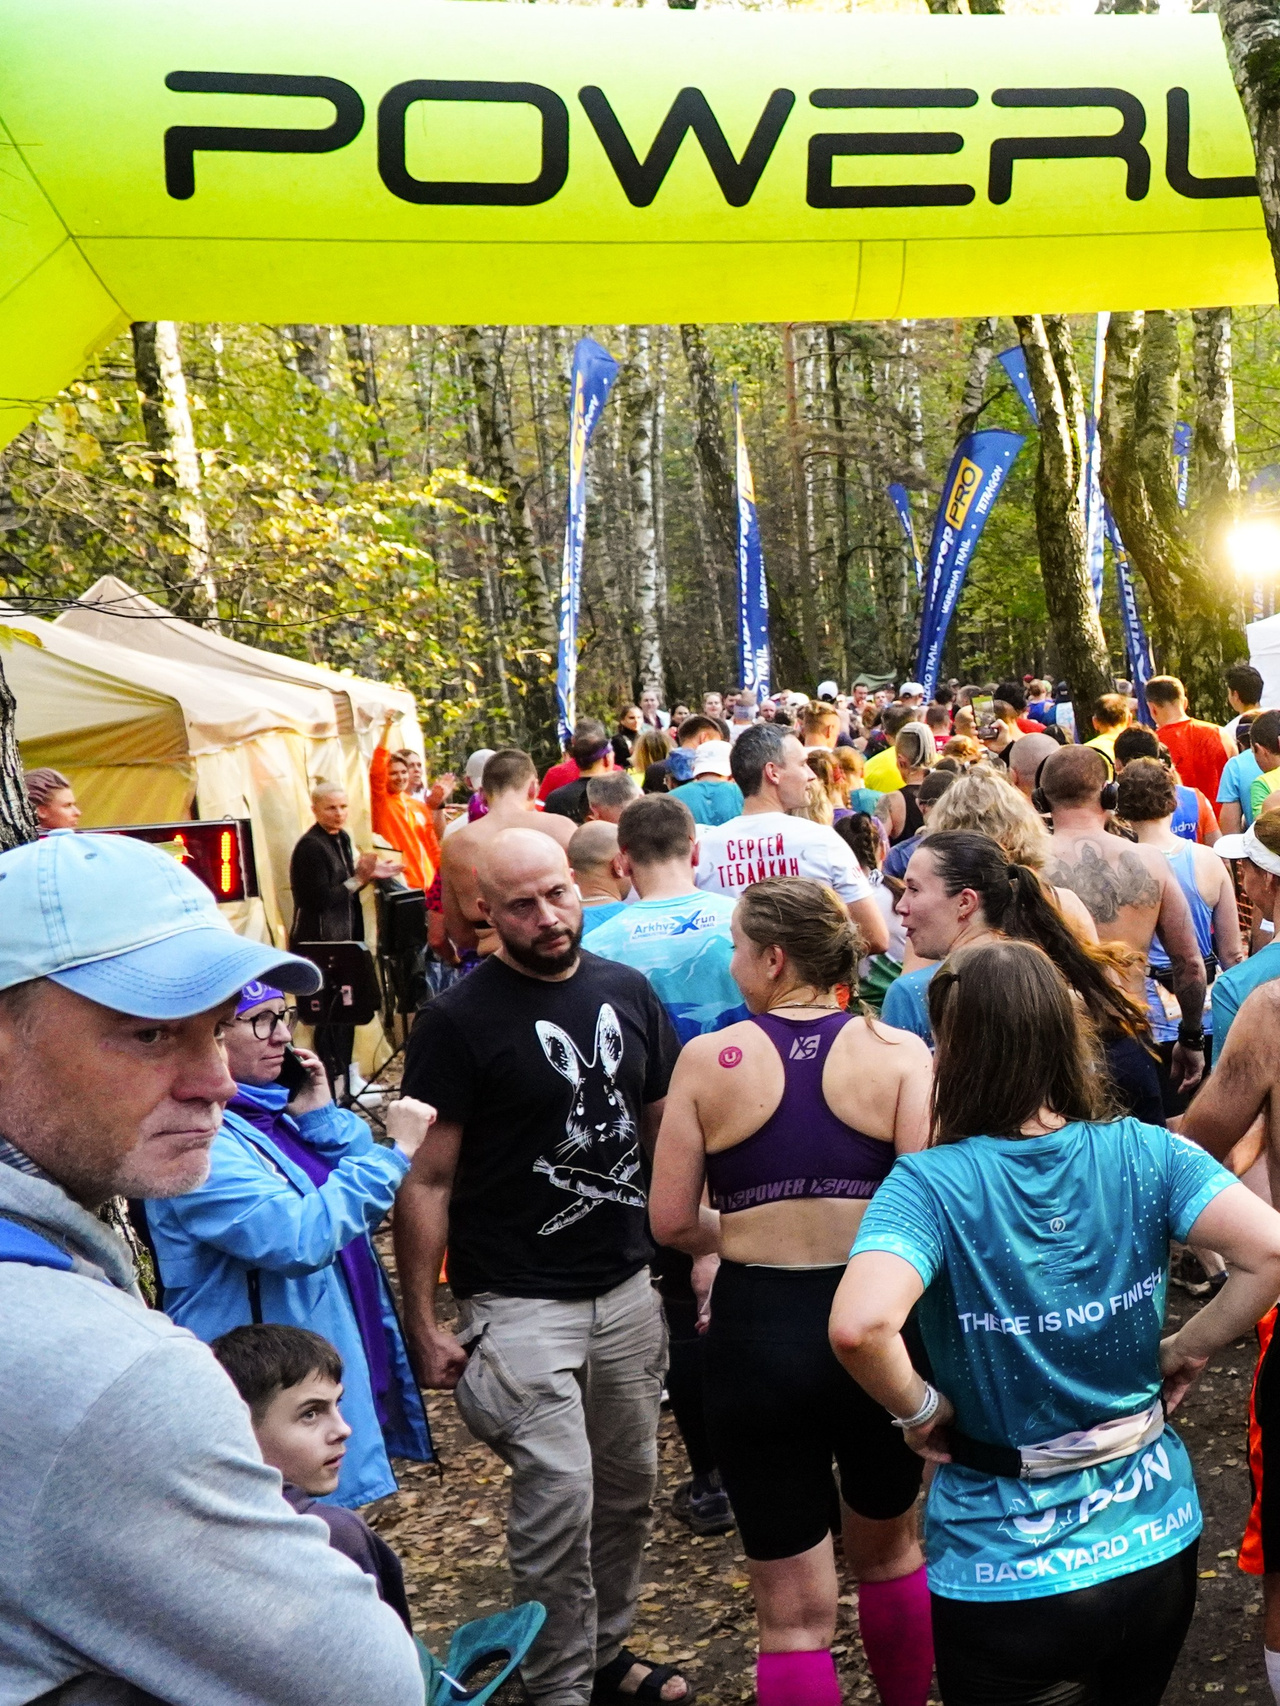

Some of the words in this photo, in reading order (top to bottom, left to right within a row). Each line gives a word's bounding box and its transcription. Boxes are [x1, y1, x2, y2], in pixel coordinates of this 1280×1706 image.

[949, 466, 976, 524] PRO
[954, 538, 971, 567] TRAIL
[975, 464, 1004, 515] TETRAGON
[717, 857, 800, 888] ТЕБАЙКИН
[726, 833, 785, 862] СЕРГЕЙ
[957, 1312, 1031, 1336] THERE
[1038, 1311, 1062, 1333] IS
[1066, 1301, 1105, 1327] NO
[1109, 1266, 1162, 1316] FINISH
[974, 1534, 1129, 1584] BACKYARD
[1133, 1501, 1194, 1547] TEAM
